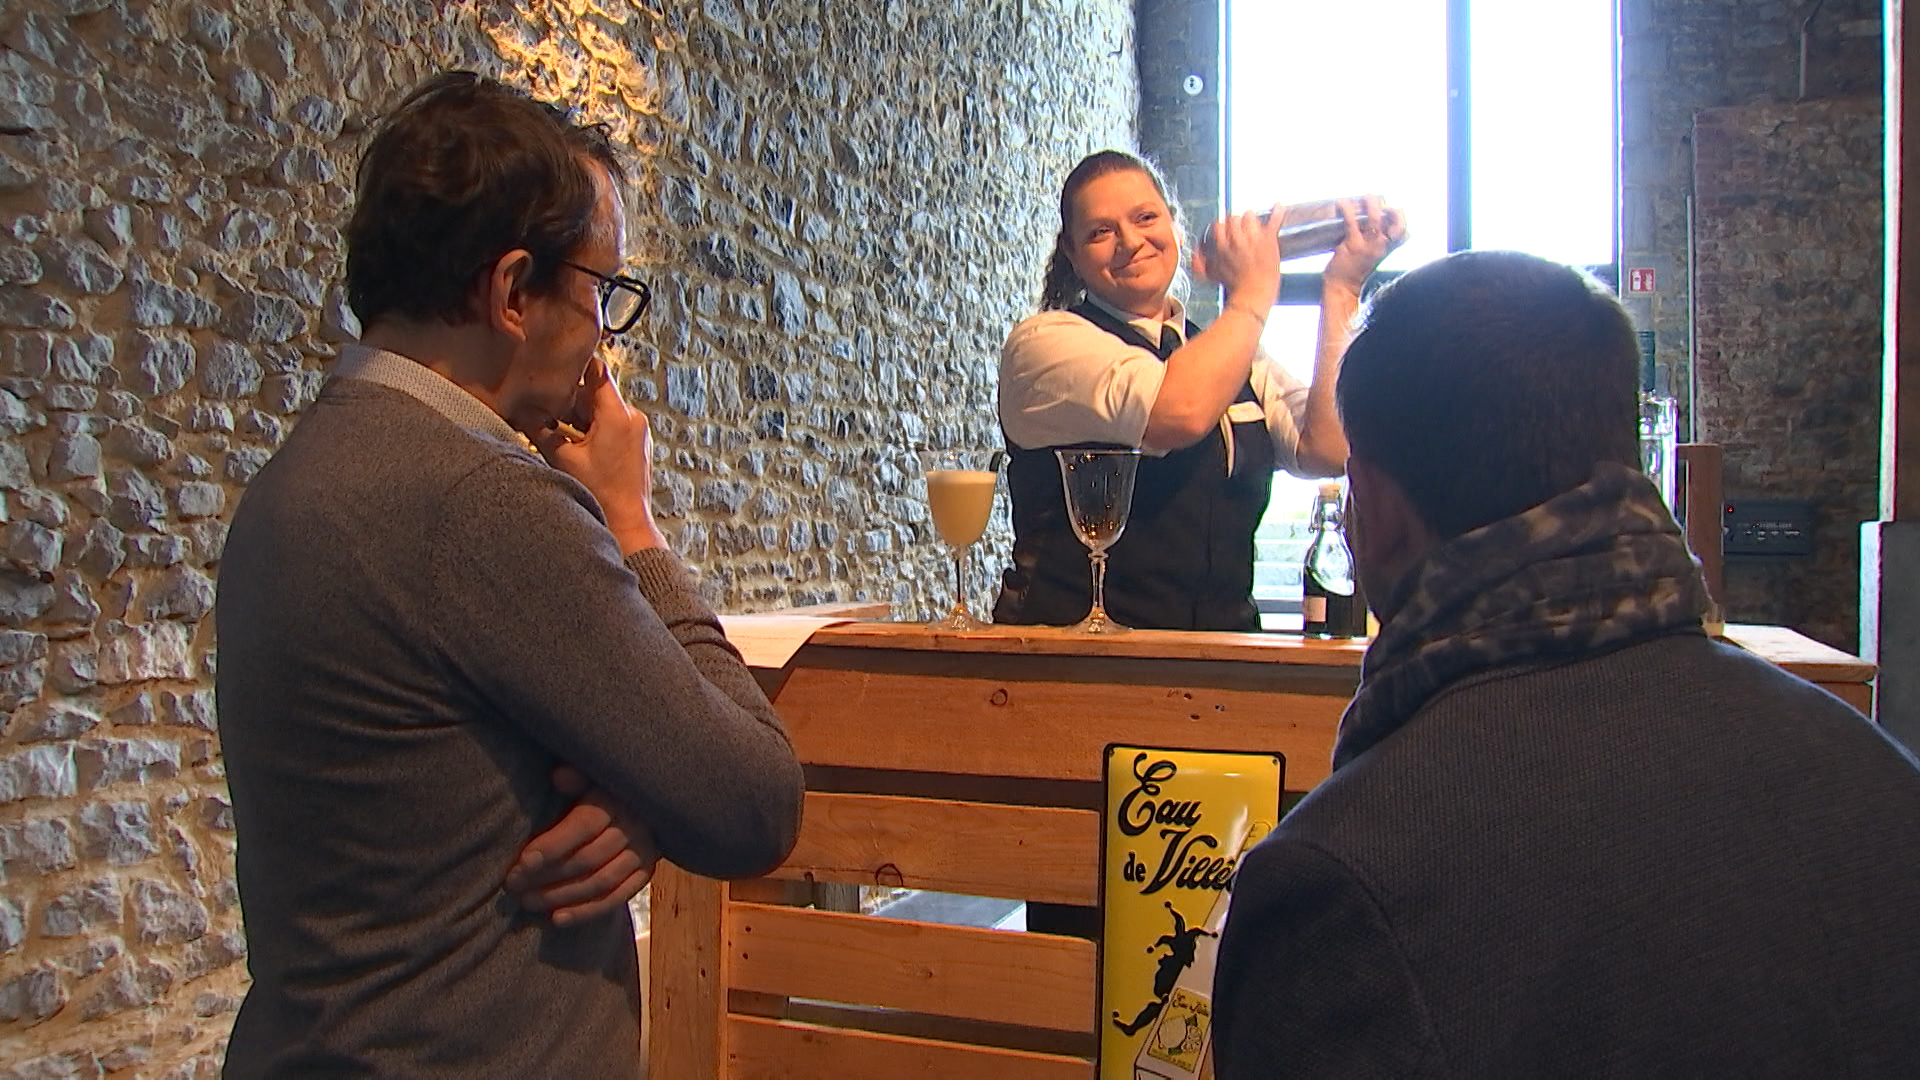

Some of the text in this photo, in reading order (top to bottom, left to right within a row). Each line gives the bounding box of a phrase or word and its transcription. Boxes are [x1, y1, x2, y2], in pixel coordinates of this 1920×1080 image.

[1118, 752, 1202, 836] Eau
[1123, 827, 1237, 894] de Villé
